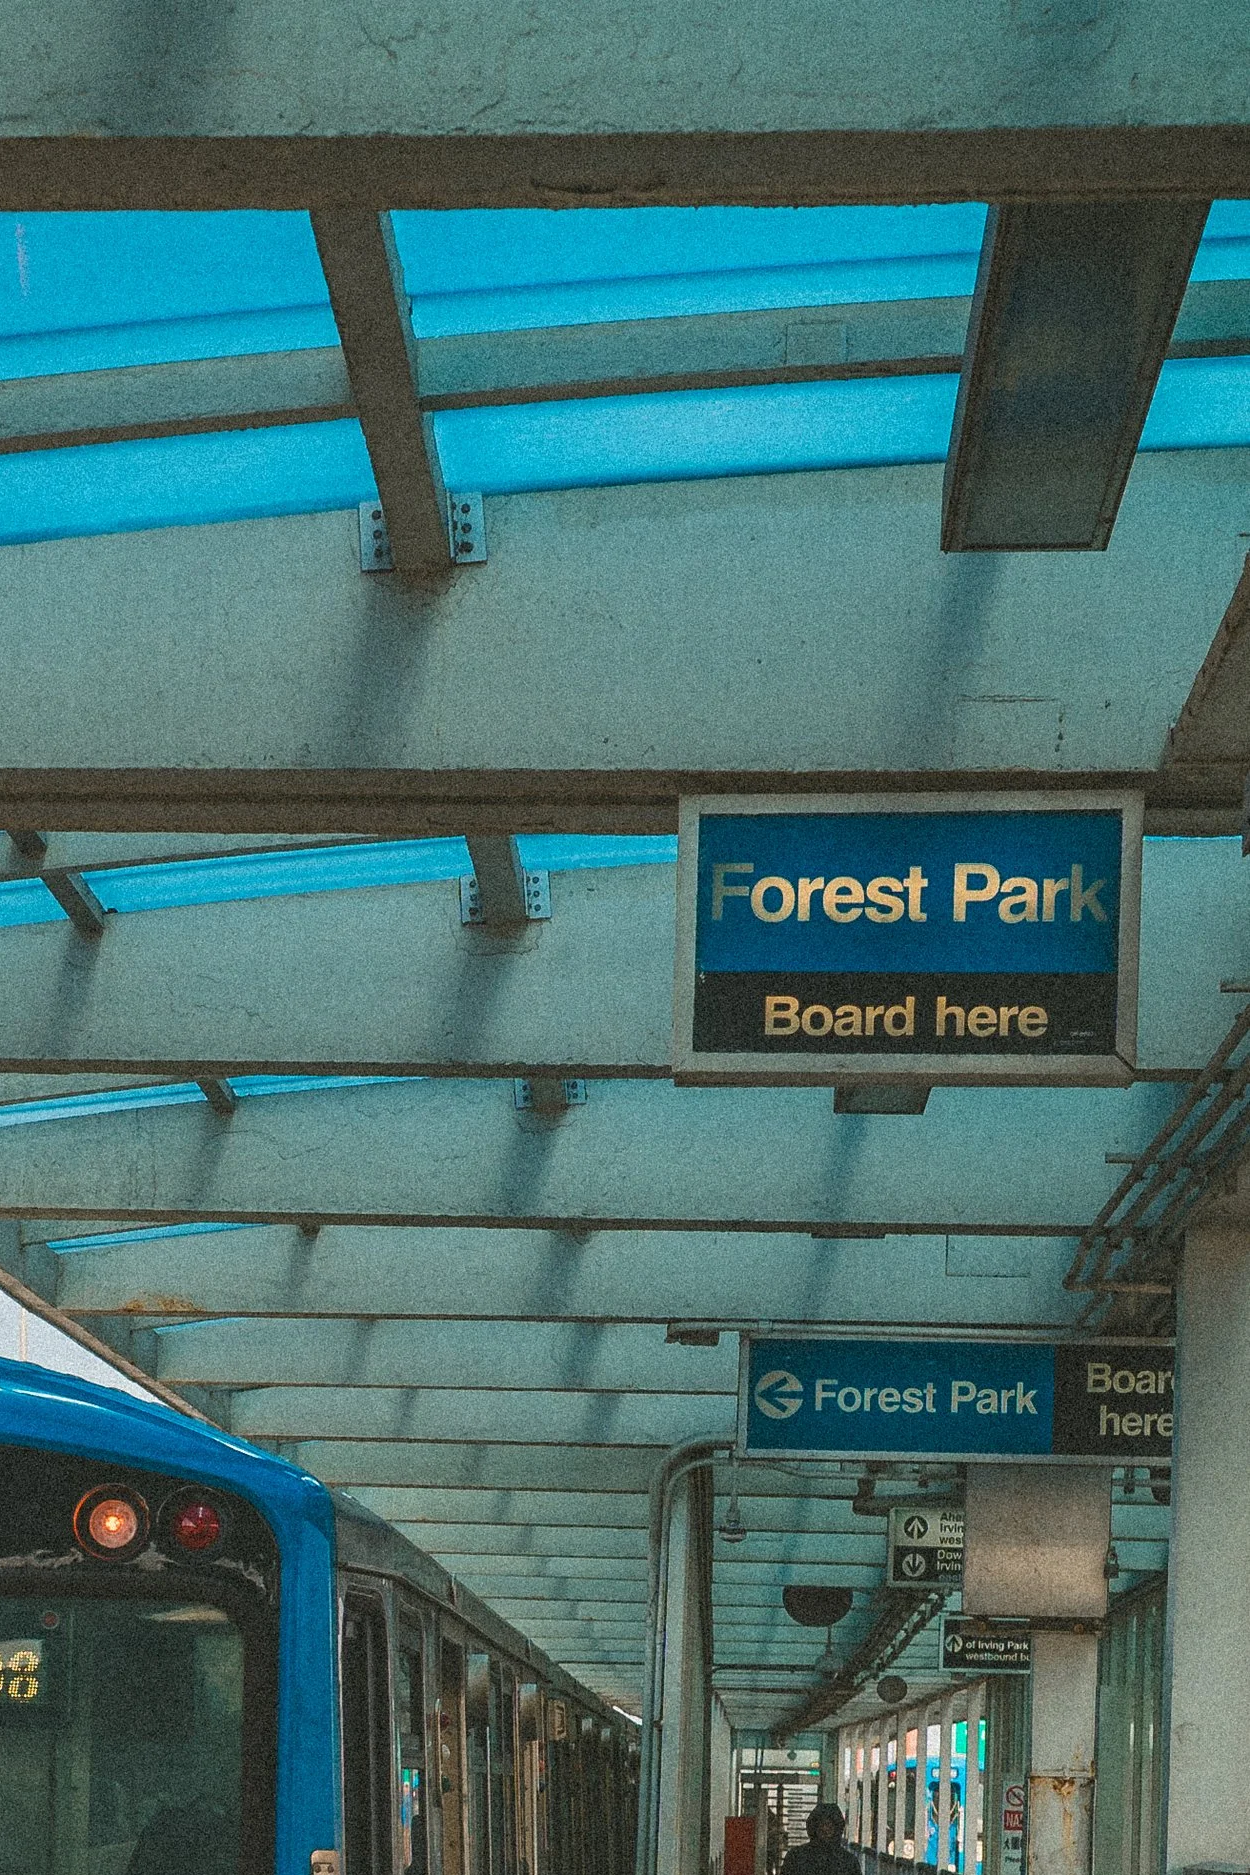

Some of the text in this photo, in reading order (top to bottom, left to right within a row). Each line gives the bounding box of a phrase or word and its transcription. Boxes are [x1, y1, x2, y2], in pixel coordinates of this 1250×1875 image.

[711, 862, 1108, 923] Forest Park
[764, 995, 1048, 1037] Board here
[1086, 1362, 1174, 1394] Boar
[815, 1378, 1038, 1415] Forest Park
[1099, 1405, 1174, 1437] here
[965, 1640, 1029, 1652] of Irving Park
[965, 1652, 1017, 1661] westbound
